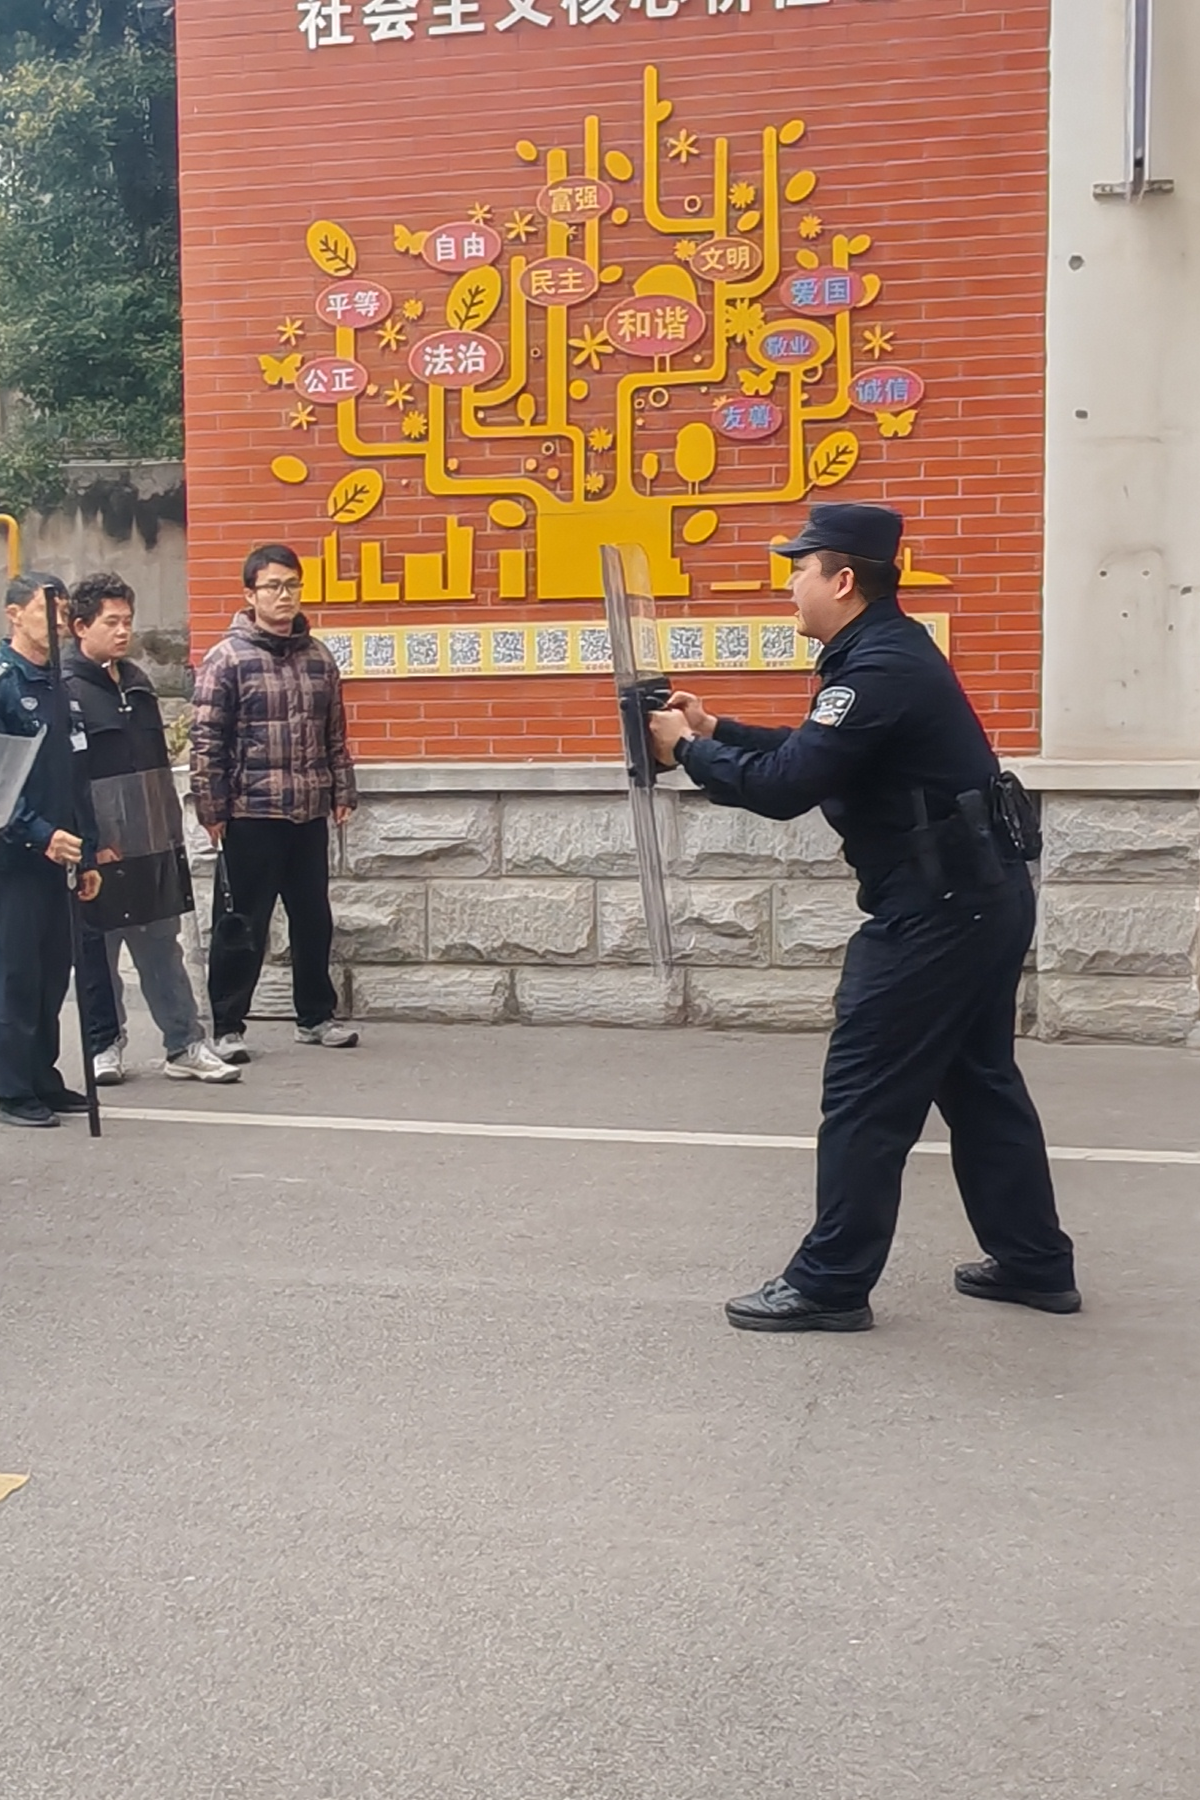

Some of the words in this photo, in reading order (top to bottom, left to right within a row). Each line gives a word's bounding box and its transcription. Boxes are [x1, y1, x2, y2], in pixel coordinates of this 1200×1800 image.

[297, 0, 831, 50] 社会主义
[548, 185, 600, 213] 富强
[434, 232, 486, 262] 自由
[700, 246, 750, 272] 文明
[530, 267, 585, 295] 民主
[790, 276, 851, 307] 爱国
[325, 290, 380, 320] 平等
[617, 306, 689, 342] 和谐
[422, 342, 487, 376] 法治
[764, 335, 811, 358] 敬业
[304, 367, 358, 394] 公正
[855, 377, 911, 405] 诚信
[721, 404, 772, 431] 友善
